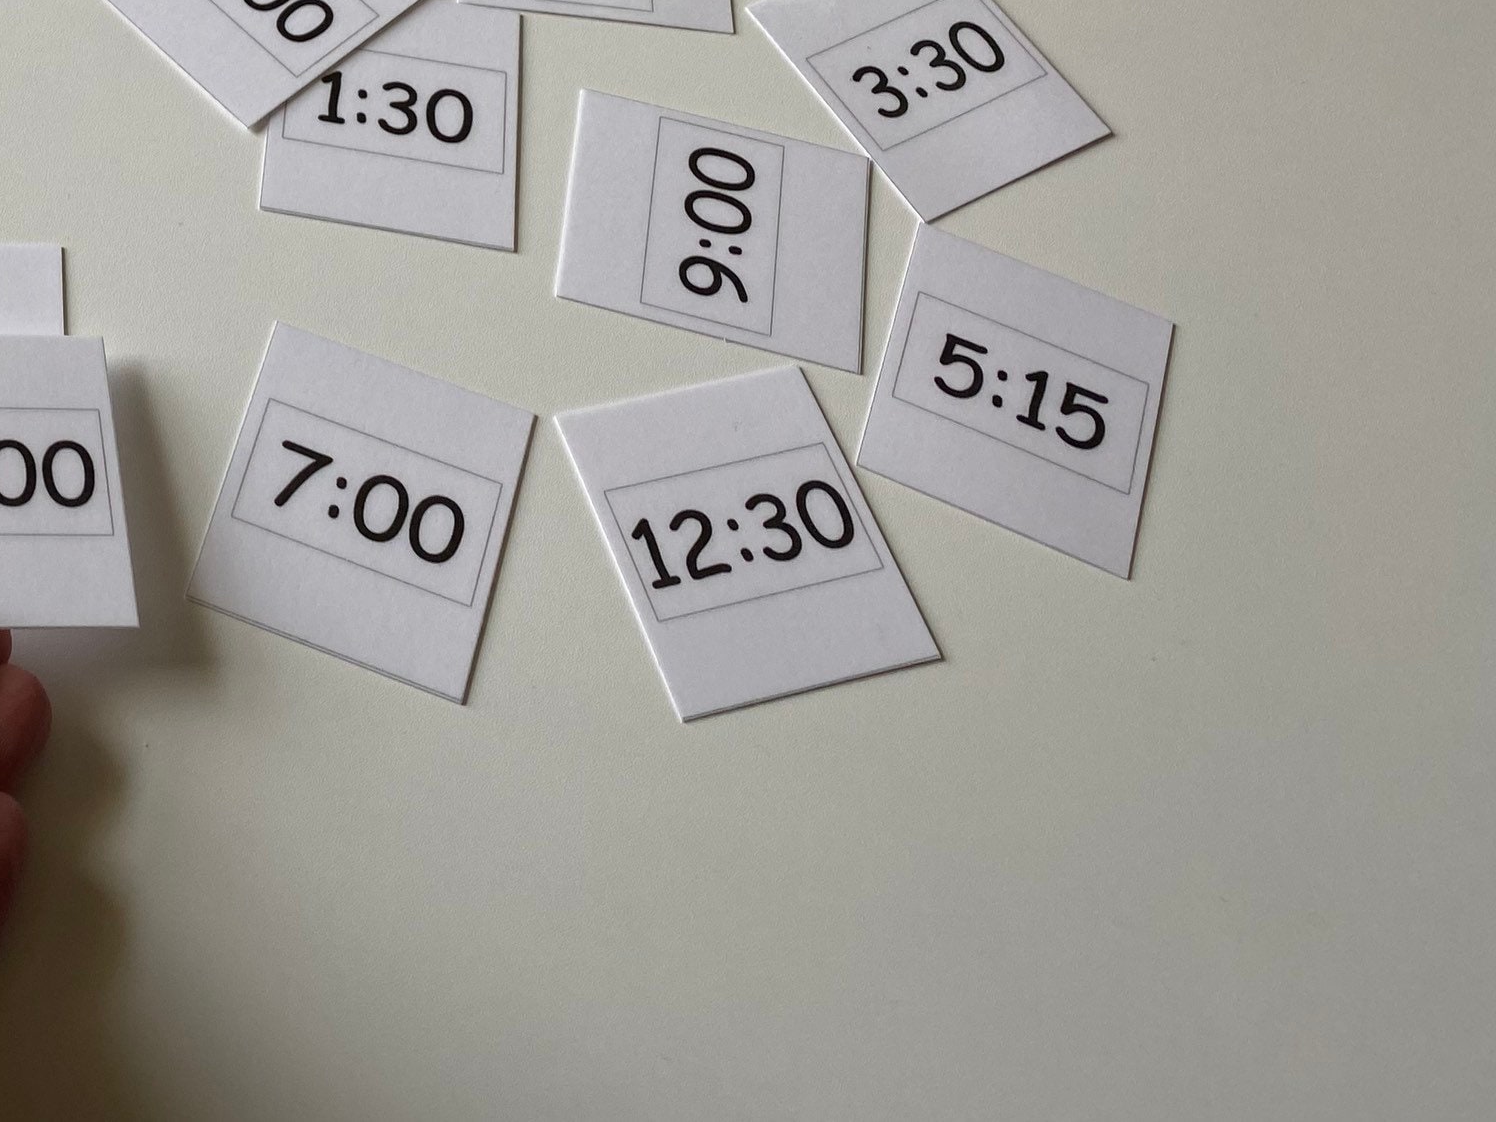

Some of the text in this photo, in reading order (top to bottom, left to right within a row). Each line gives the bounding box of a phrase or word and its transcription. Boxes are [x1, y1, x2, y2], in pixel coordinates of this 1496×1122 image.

[316, 70, 474, 144] 1:30
[851, 21, 1005, 119] 3:30
[678, 147, 756, 304] 9:00
[933, 332, 1109, 451] 5:15
[273, 439, 465, 564] 7:00
[631, 479, 855, 590] 12:30
